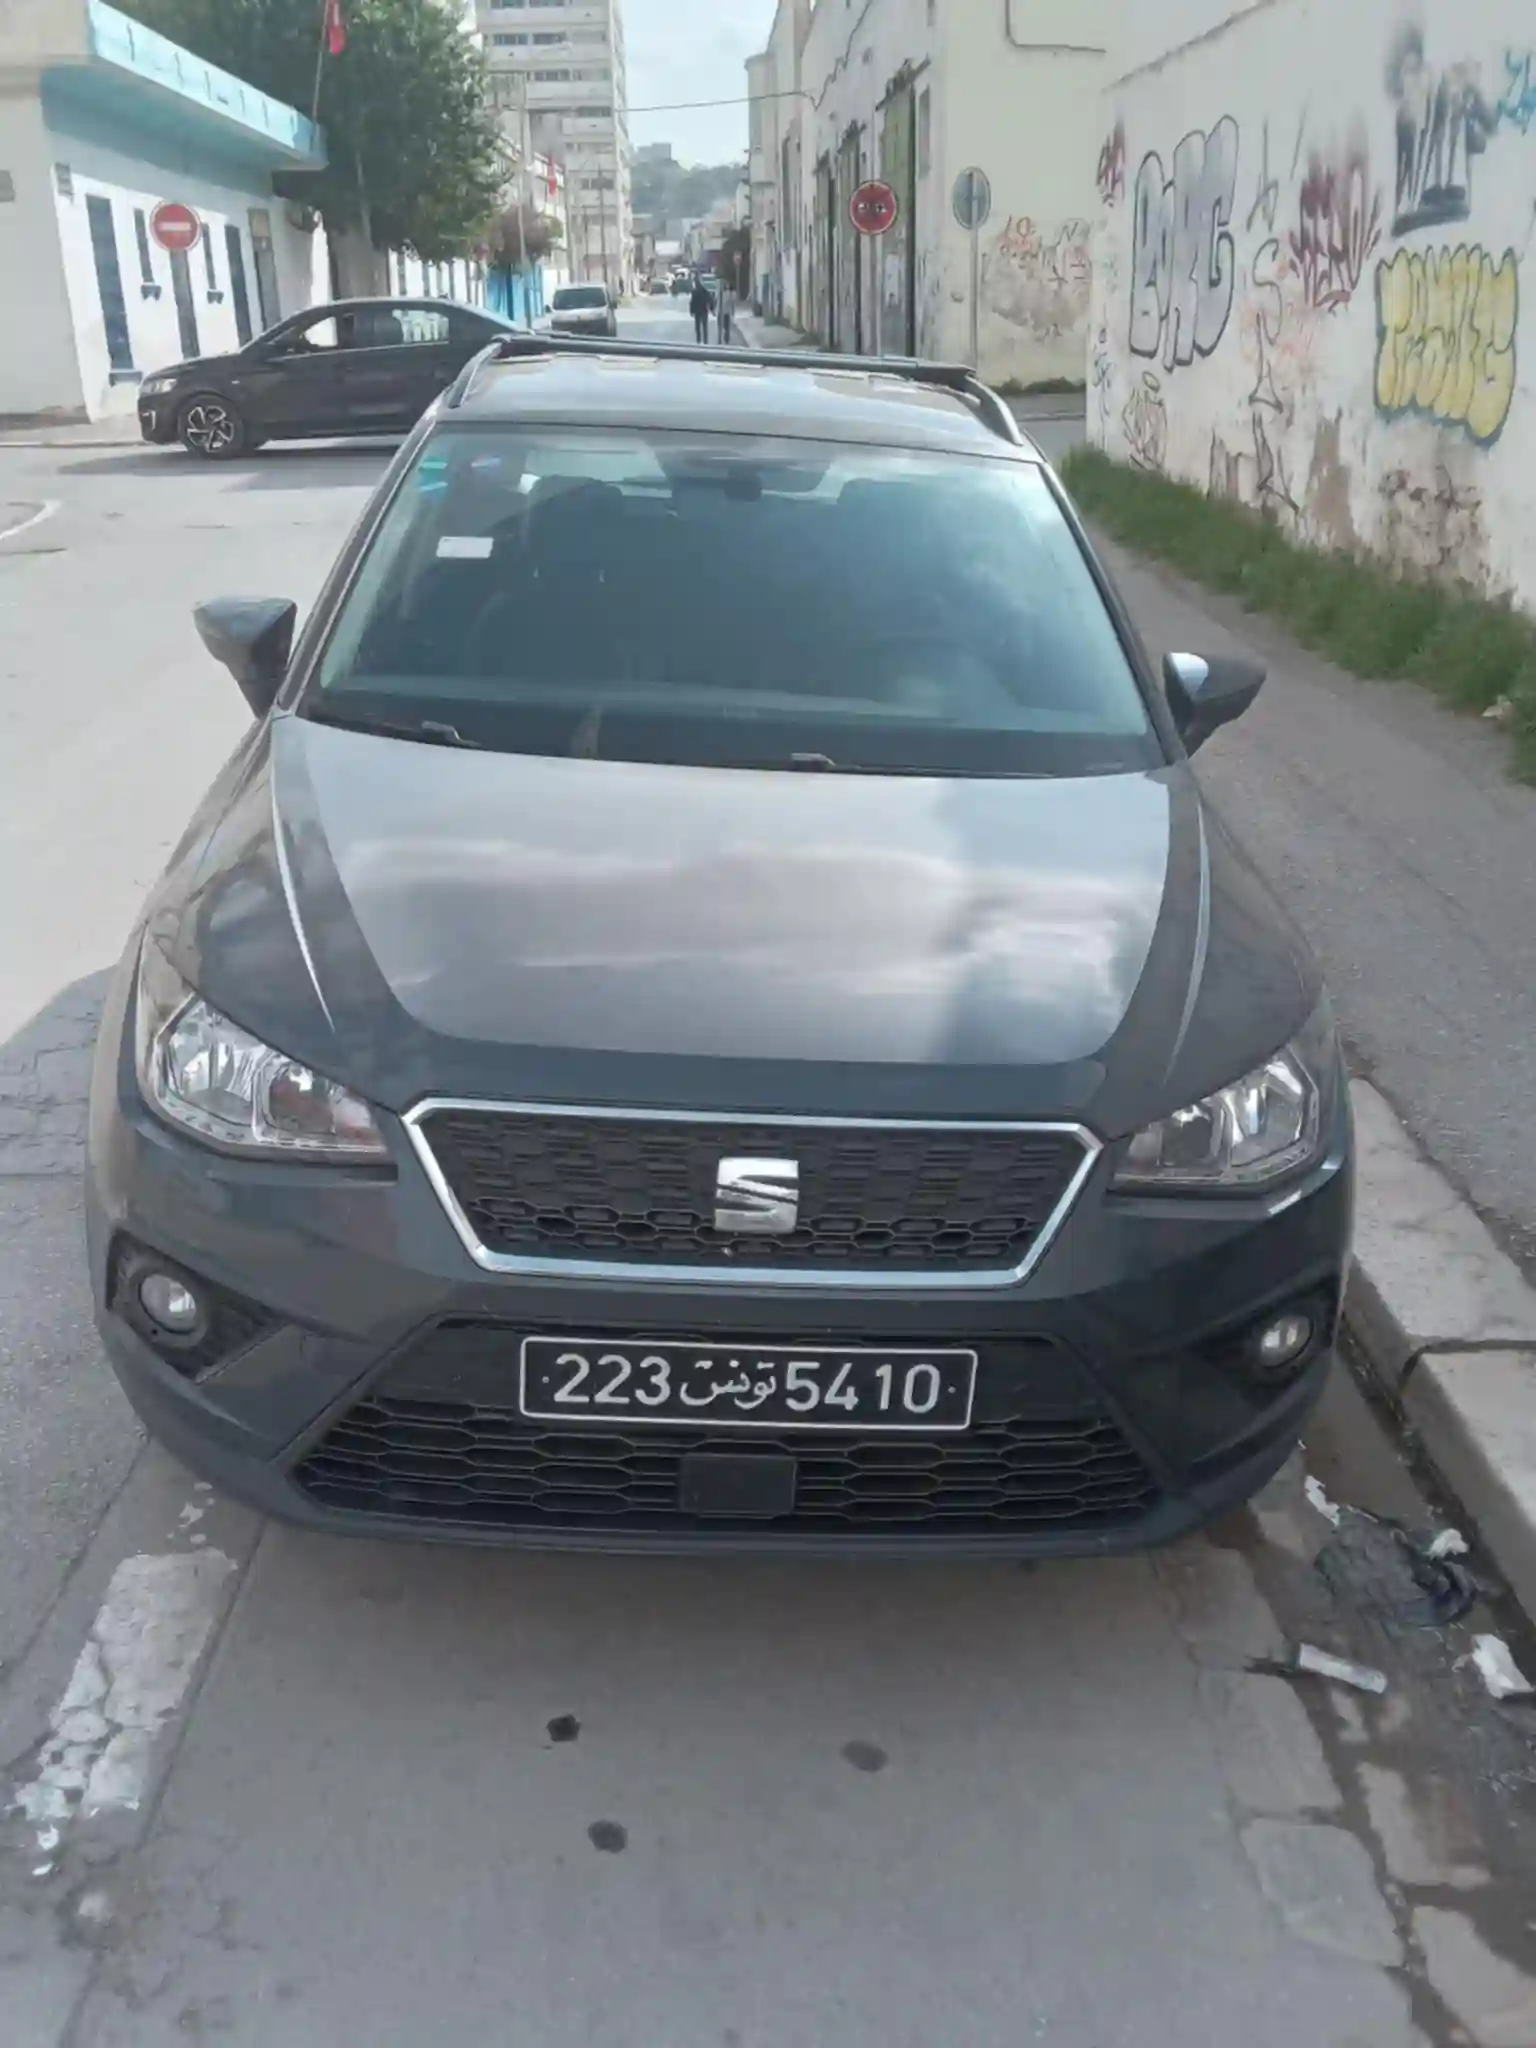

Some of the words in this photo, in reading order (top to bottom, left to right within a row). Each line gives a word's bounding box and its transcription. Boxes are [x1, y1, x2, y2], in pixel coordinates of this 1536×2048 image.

[553, 1353, 671, 1406] 223
[680, 1359, 777, 1410] تونس
[785, 1361, 941, 1414] 5410
